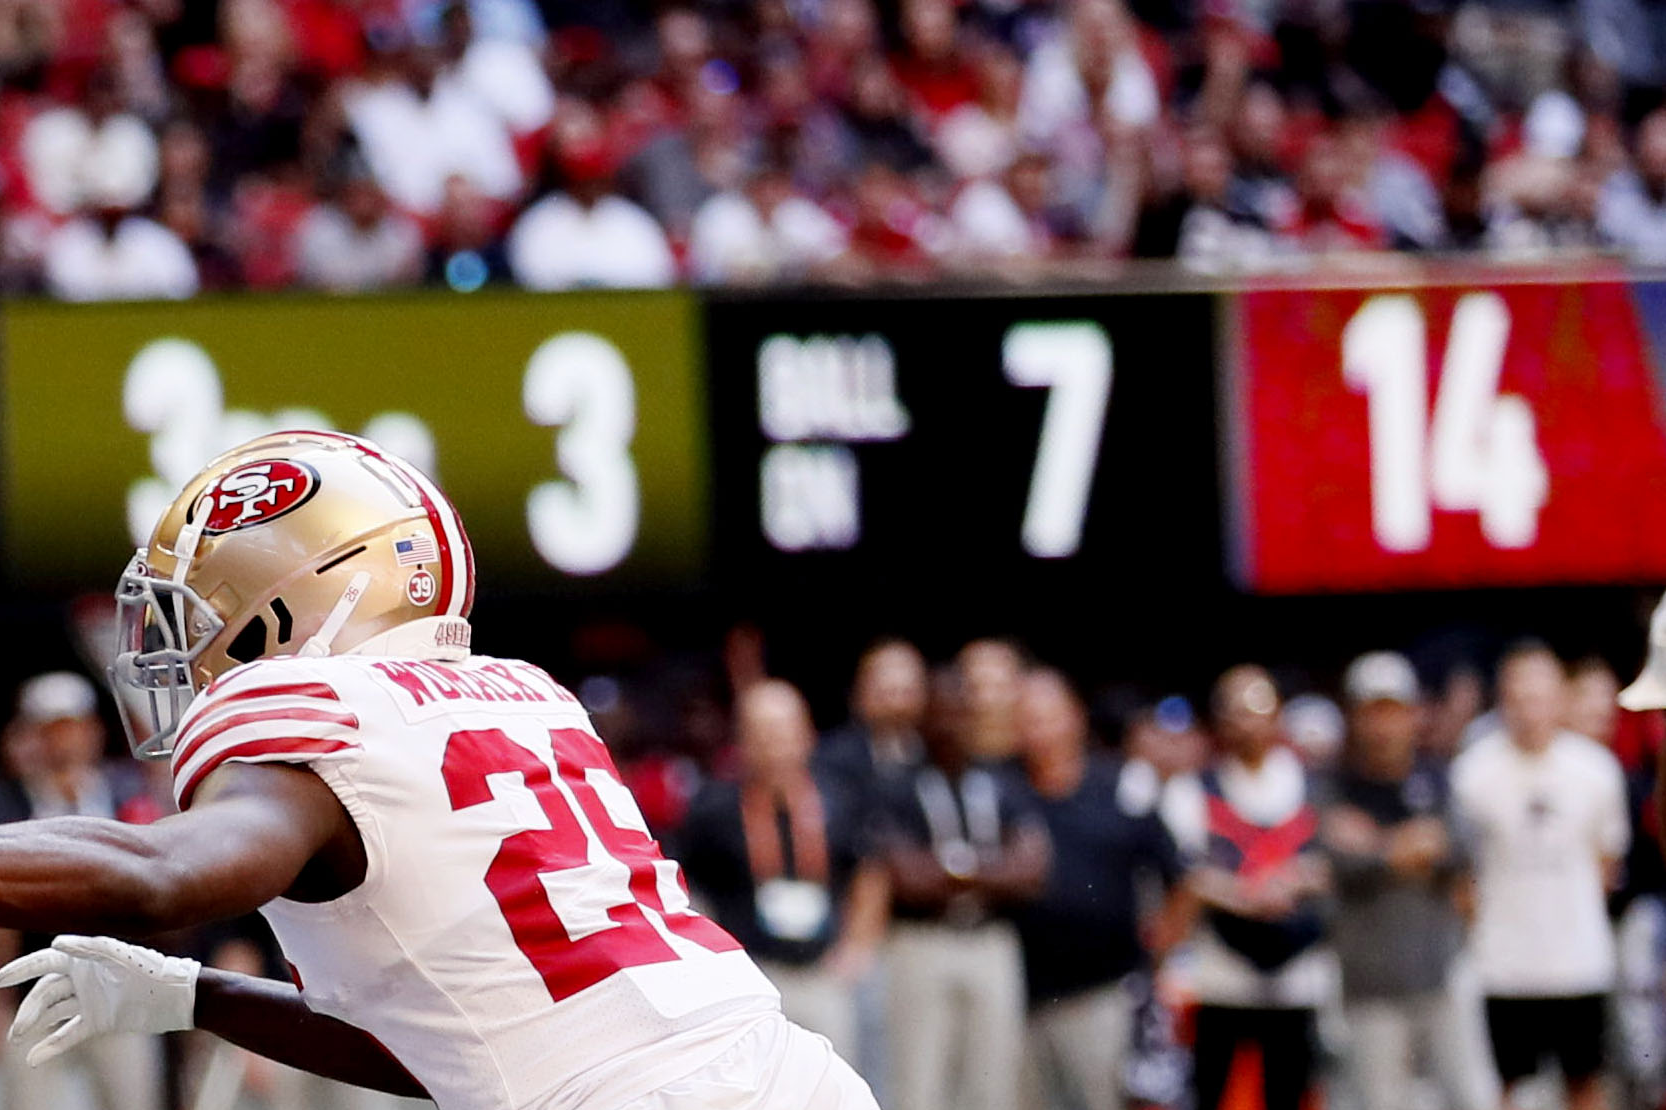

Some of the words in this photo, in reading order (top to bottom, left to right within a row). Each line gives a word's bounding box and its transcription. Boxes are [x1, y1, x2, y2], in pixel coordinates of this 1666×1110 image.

[525, 331, 637, 574] 3
[1002, 319, 1113, 557] 7
[1340, 291, 1550, 553] 14
[344, 586, 360, 602] 26
[410, 577, 432, 598] 39
[441, 728, 743, 1003] 26
